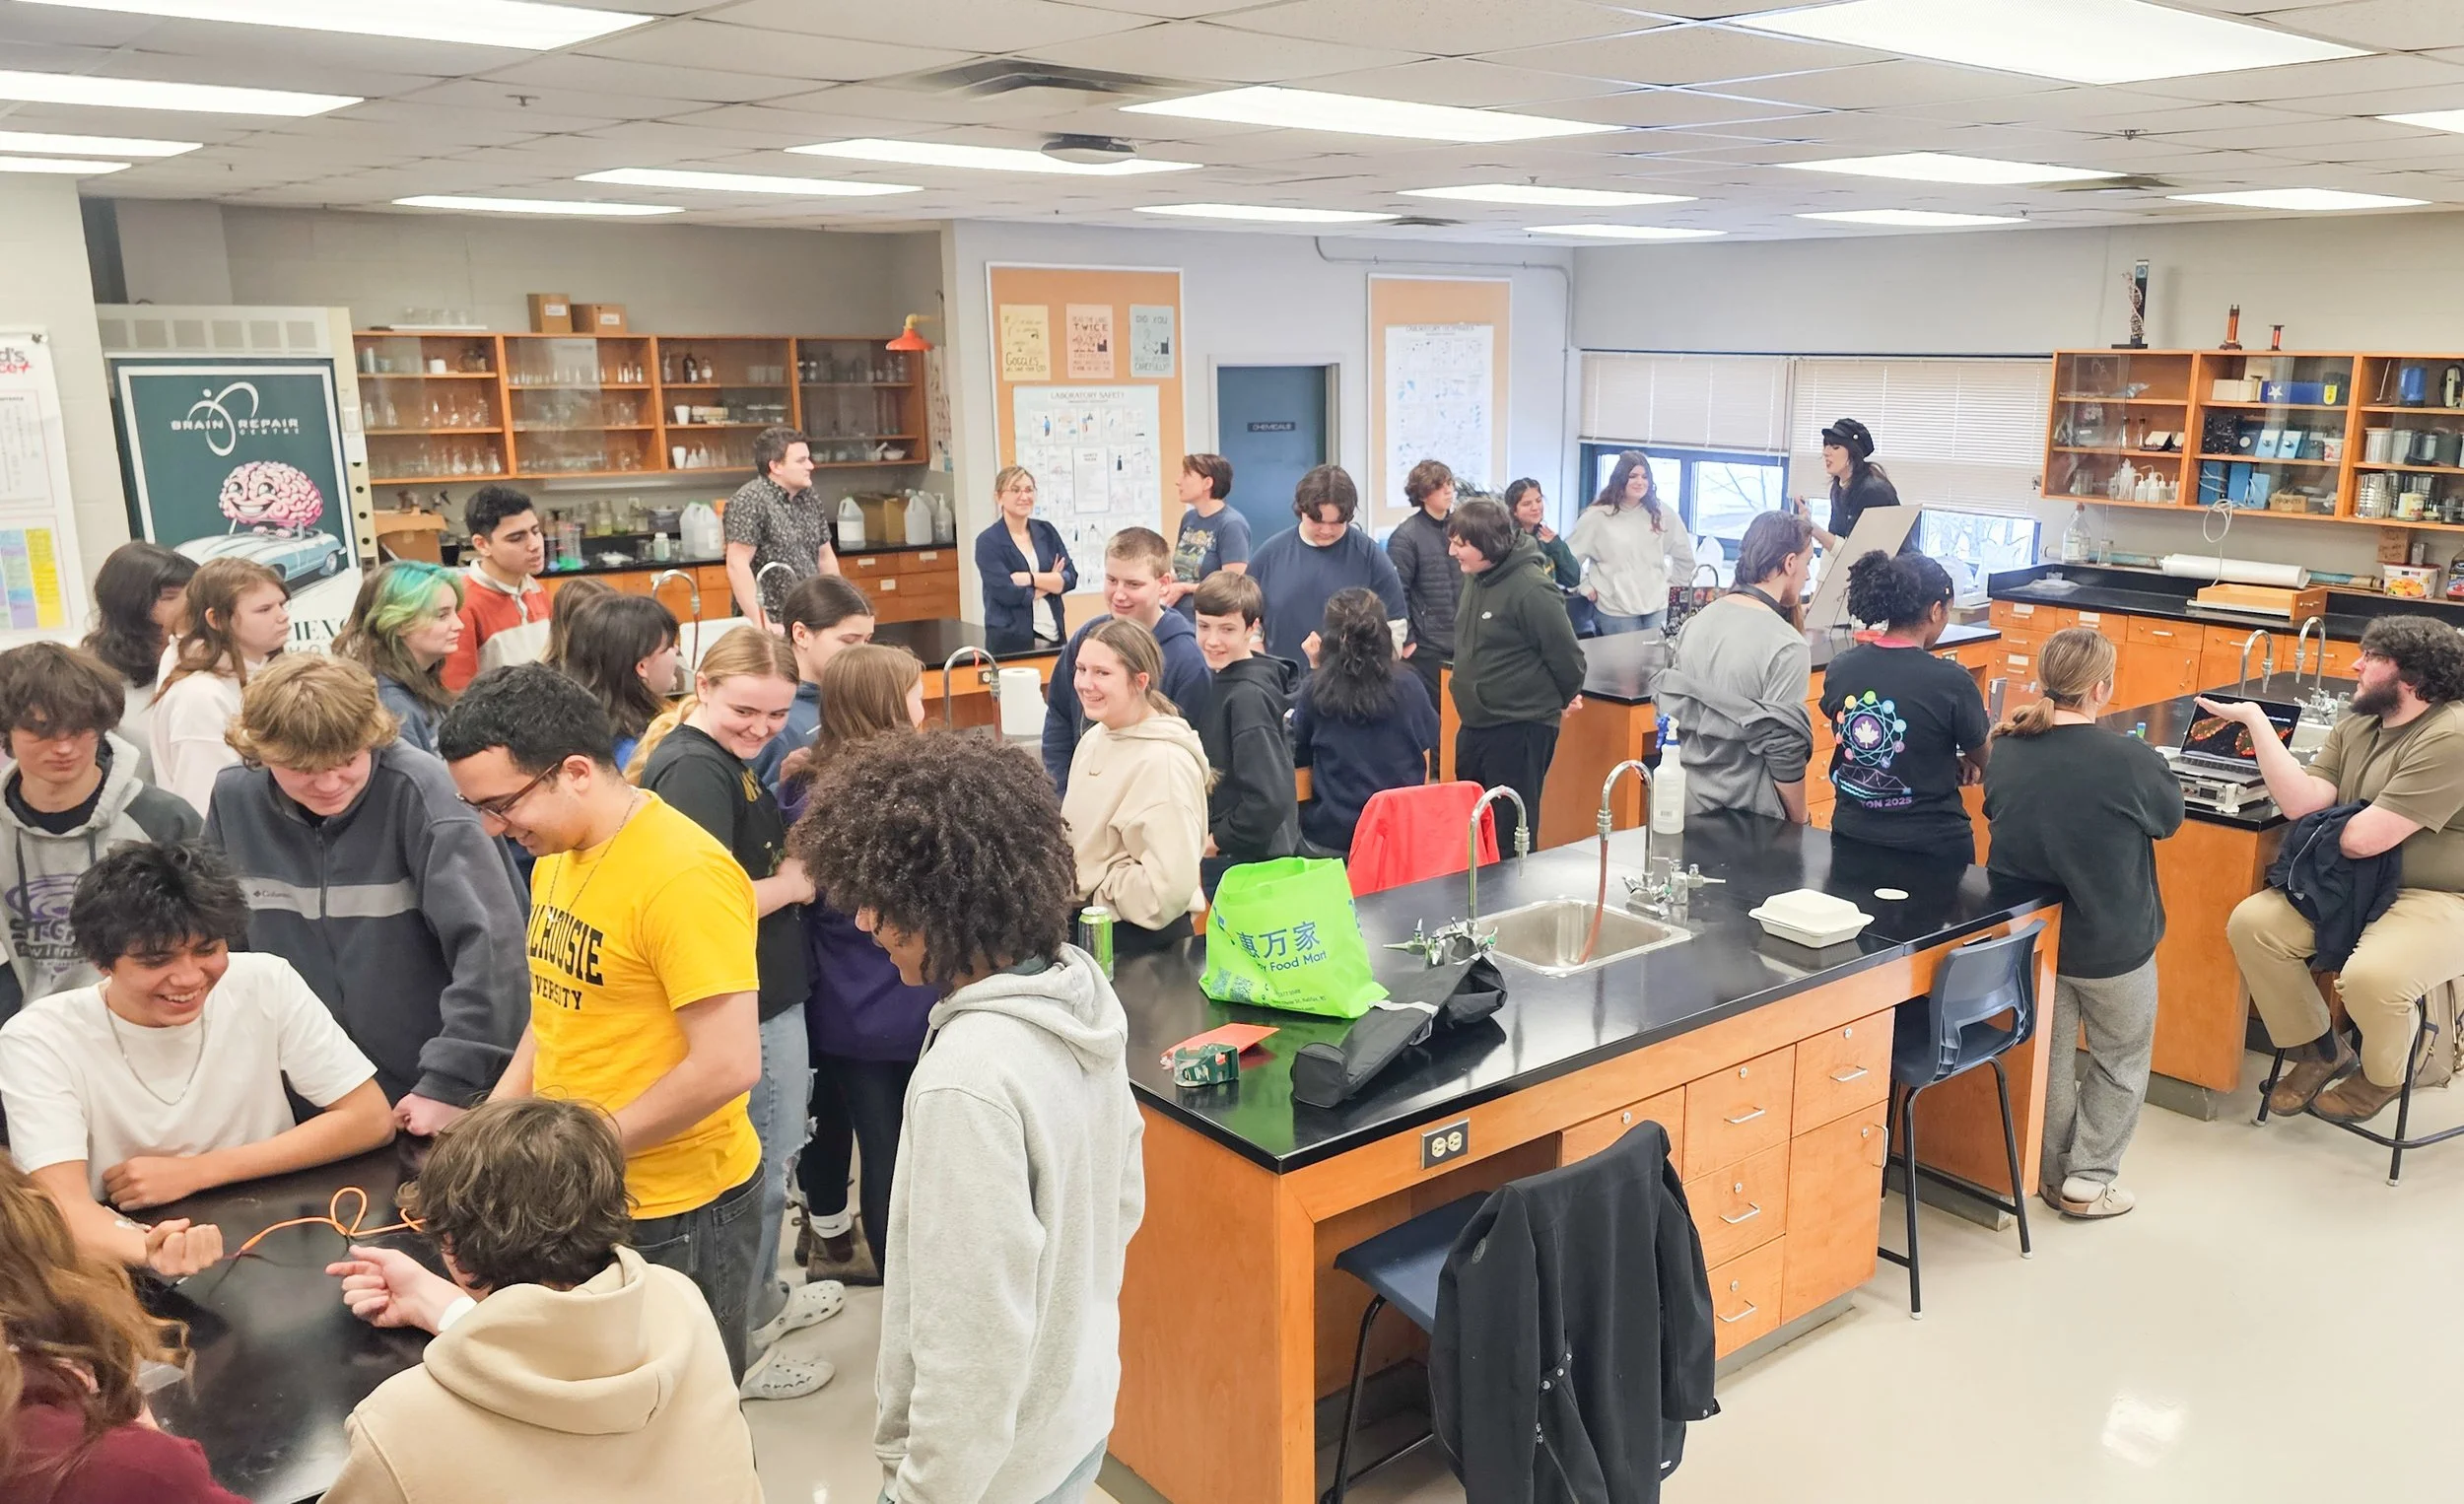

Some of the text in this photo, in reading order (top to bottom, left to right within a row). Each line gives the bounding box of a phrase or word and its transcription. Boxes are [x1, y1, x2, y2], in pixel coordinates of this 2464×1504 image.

[171, 418, 299, 431] BRAIN REPAIR
[1884, 796, 1912, 807] 2025
[1269, 956, 1300, 972] Food
[1303, 950, 1327, 965] Mart
